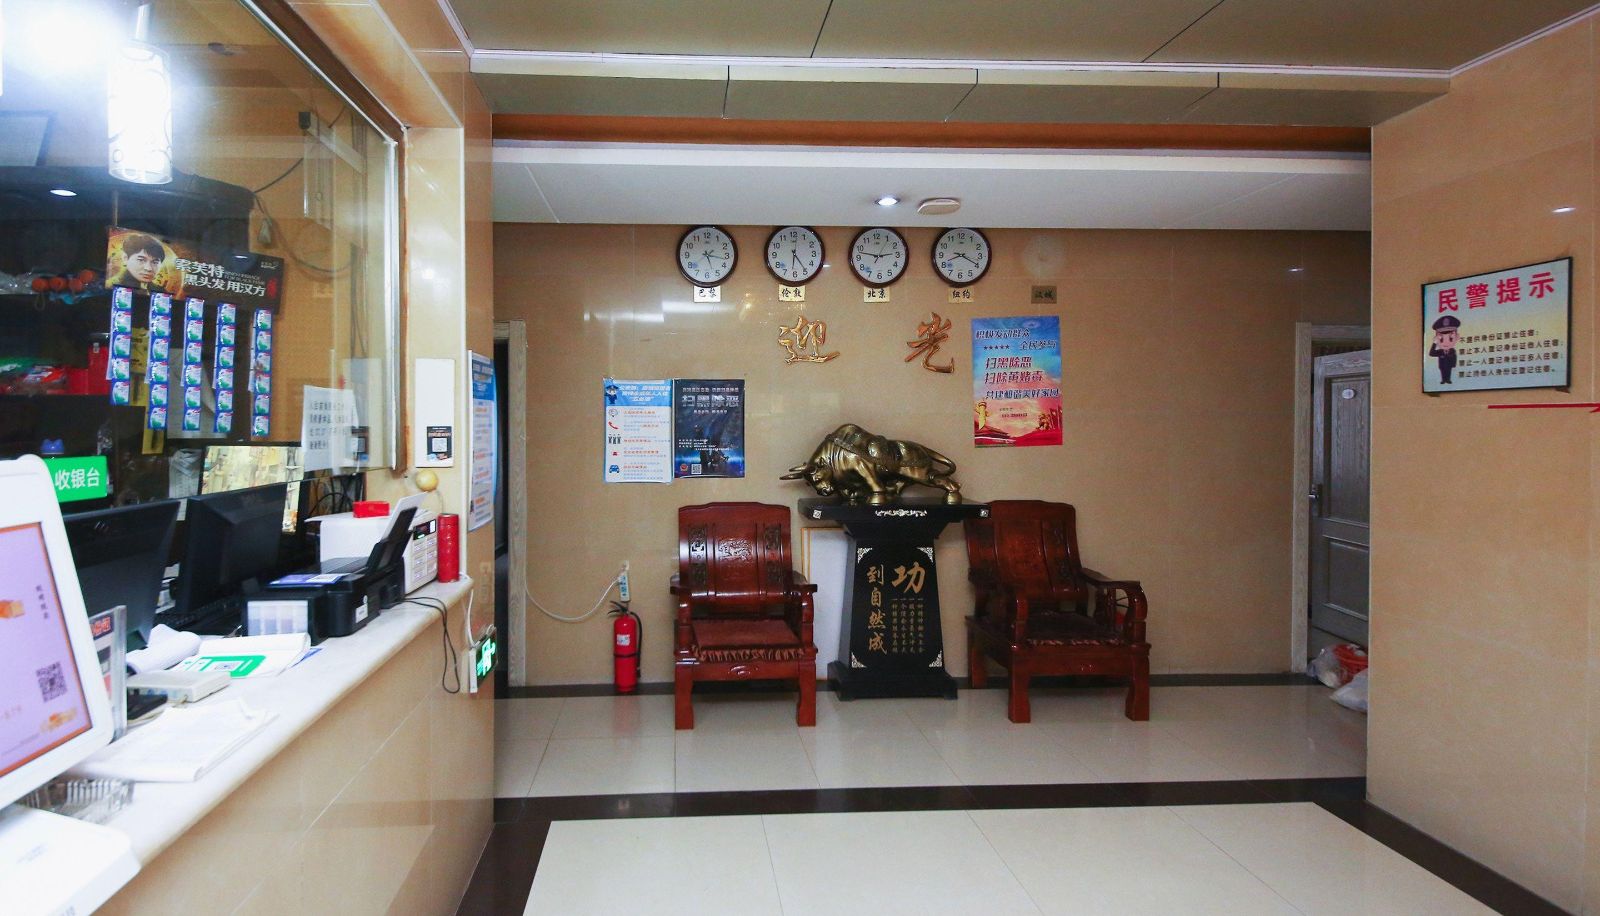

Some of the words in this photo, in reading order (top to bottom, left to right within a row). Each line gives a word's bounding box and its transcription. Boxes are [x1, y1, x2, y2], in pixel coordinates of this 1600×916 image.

[722, 242, 728, 250] 2
[809, 241, 815, 249] 2
[724, 252, 730, 260] 3
[811, 250, 817, 258] 3
[977, 252, 983, 260] 3
[714, 269, 721, 277] 5
[781, 287, 802, 298] 伦敦
[867, 289, 886, 299] 北京
[952, 290, 971, 299] 纽约
[1438, 271, 1555, 313] 民警提示
[985, 356, 1032, 369] 扫黑除恶
[984, 370, 1043, 384] 扫除黄赌毒
[54, 466, 101, 491] 收银台
[891, 561, 926, 594] 功
[866, 563, 888, 655] 到自然成
